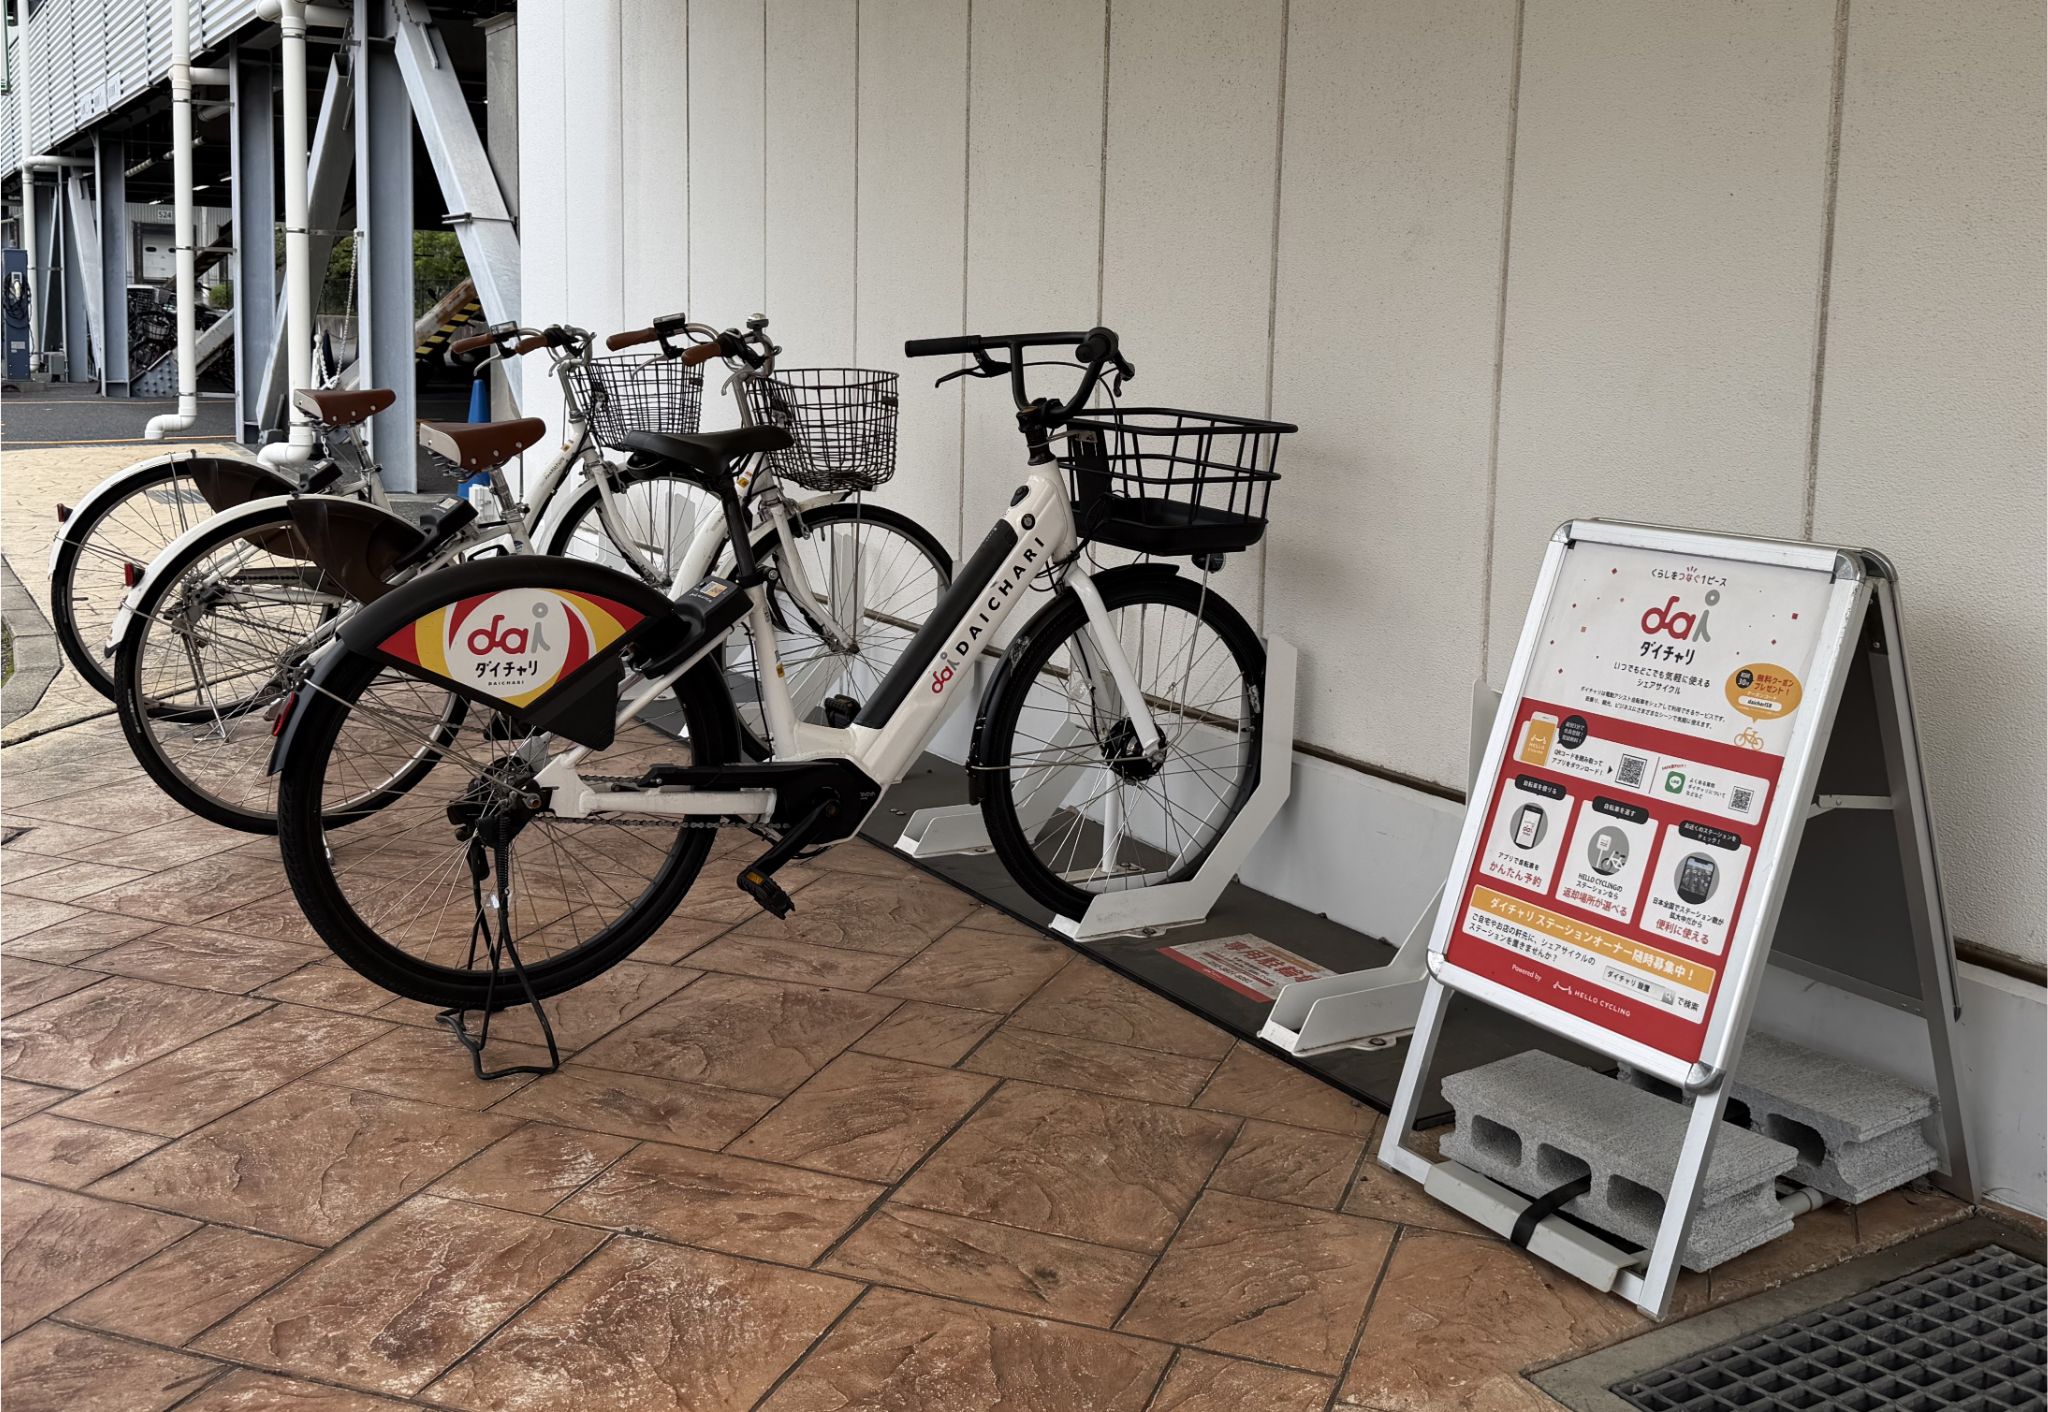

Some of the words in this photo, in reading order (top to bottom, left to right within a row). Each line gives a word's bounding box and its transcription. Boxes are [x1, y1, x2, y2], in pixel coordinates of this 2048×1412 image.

[1651, 568, 1727, 587] くらしをつなぐ1ピース
[955, 537, 1044, 656] DAICHARI
[1641, 589, 1720, 642] dai
[467, 602, 551, 656] dai
[1640, 641, 1696, 665] ダイチャリ
[475, 660, 539, 678] ダイチャリ
[931, 651, 960, 693] dai
[1614, 661, 1710, 688] いつでもどこでも気軽に使える
[1637, 678, 1680, 695] シェアサイクル
[1498, 851, 1539, 871] アプリで自転車を
[1489, 861, 1542, 887] かんたん予約
[1562, 886, 1628, 917] 返却場所が選べる
[1576, 880, 1619, 900] ステーションなら
[1489, 897, 1534, 921] ダイチャリ
[1656, 919, 1709, 945] 便利に使える
[1511, 963, 1534, 979] Powered
[1534, 971, 1543, 983] by
[1607, 969, 1637, 988] ダイチャリ
[1574, 990, 1599, 1005] HELLO
[1599, 999, 1631, 1017] CYCLING
[1677, 996, 1700, 1012] で検索
